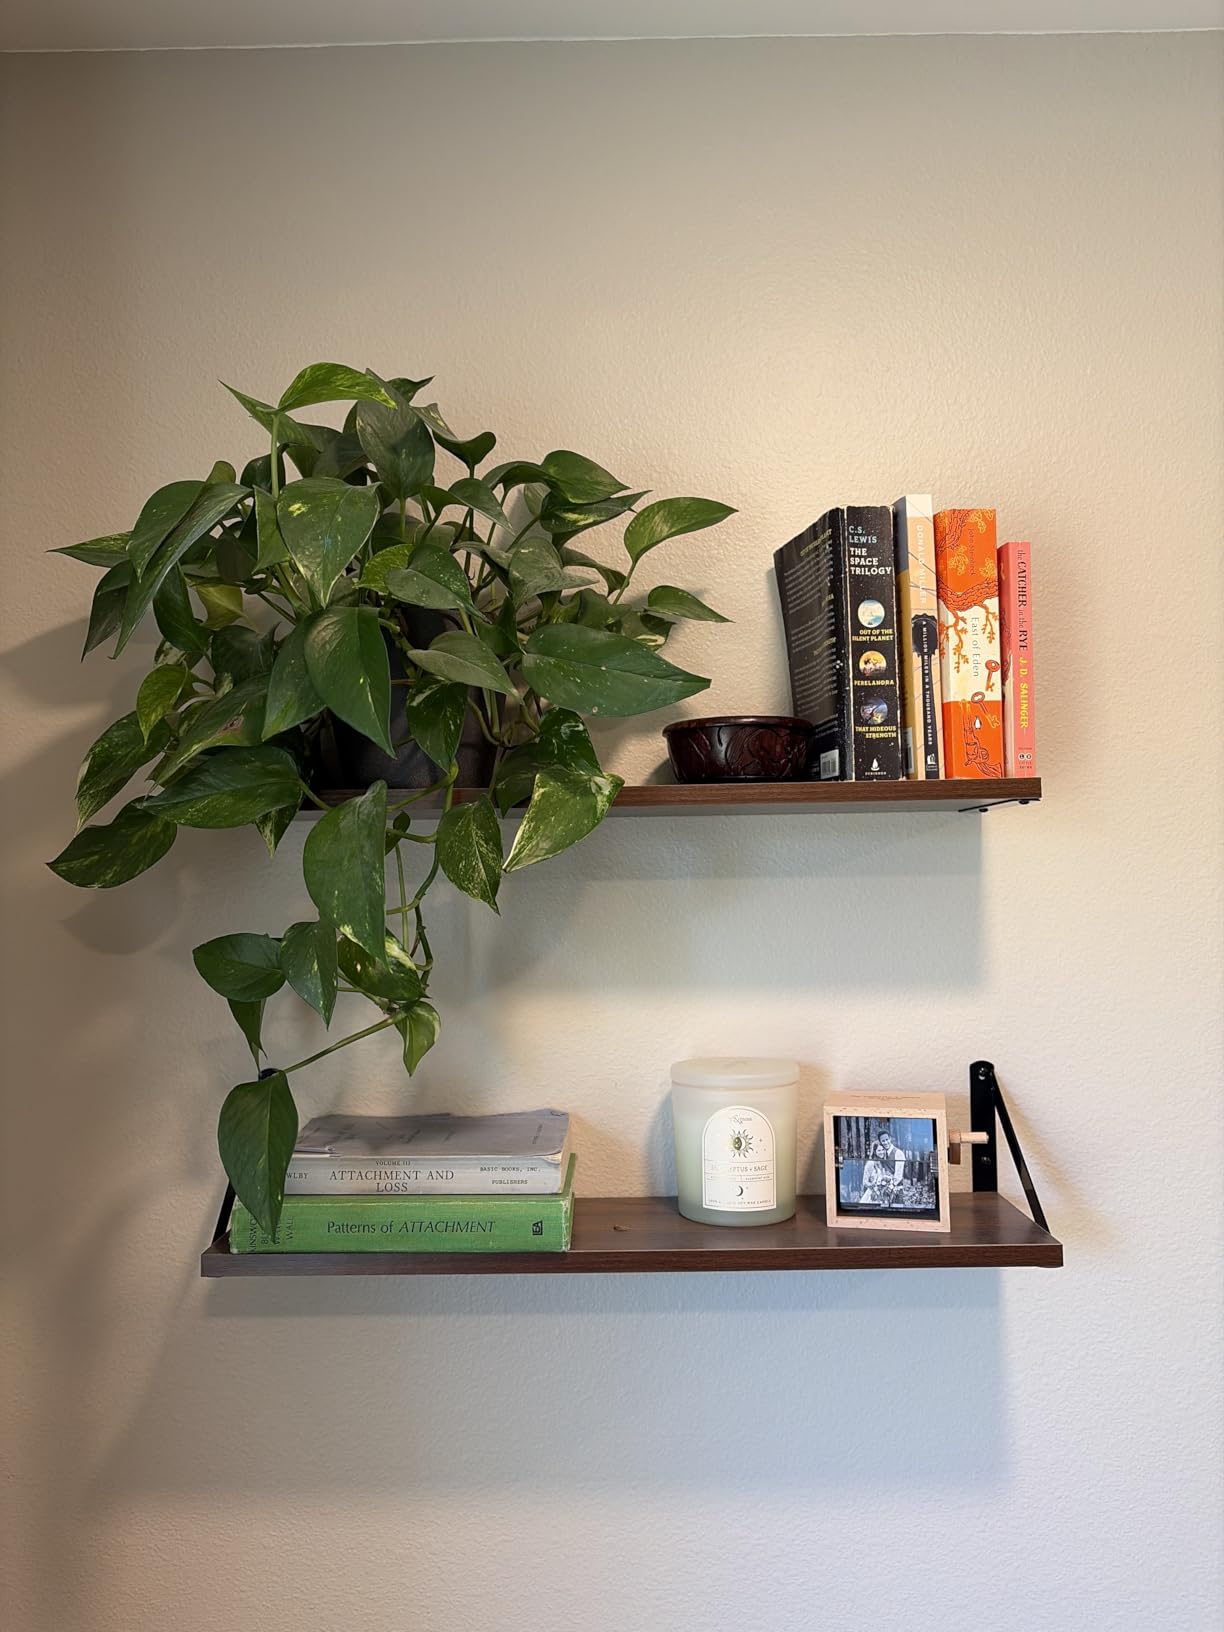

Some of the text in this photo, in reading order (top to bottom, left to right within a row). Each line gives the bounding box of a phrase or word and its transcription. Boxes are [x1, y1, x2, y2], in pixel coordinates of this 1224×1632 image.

[848, 525, 866, 534] C.S.
[848, 535, 878, 544] LEWIS
[849, 547, 868, 556] THE
[1017, 549, 1026, 561] the
[849, 557, 879, 566] SPACE
[916, 524, 927, 604] DONALD MILLER
[849, 566, 892, 575] TRILOGY
[1017, 561, 1027, 607] CATCHER
[1018, 617, 1027, 629] the
[1018, 629, 1028, 651] RYE
[971, 617, 981, 677] East of Eden
[924, 675, 929, 683] IN
[1019, 682, 1029, 729] SALINGER
[329, 1169, 455, 1182] ATTACHMENT AND
[375, 1182, 409, 1193] LOSS
[285, 1216, 294, 1240] WALL
[327, 1220, 496, 1234] Patterns of ATTACHMENT
